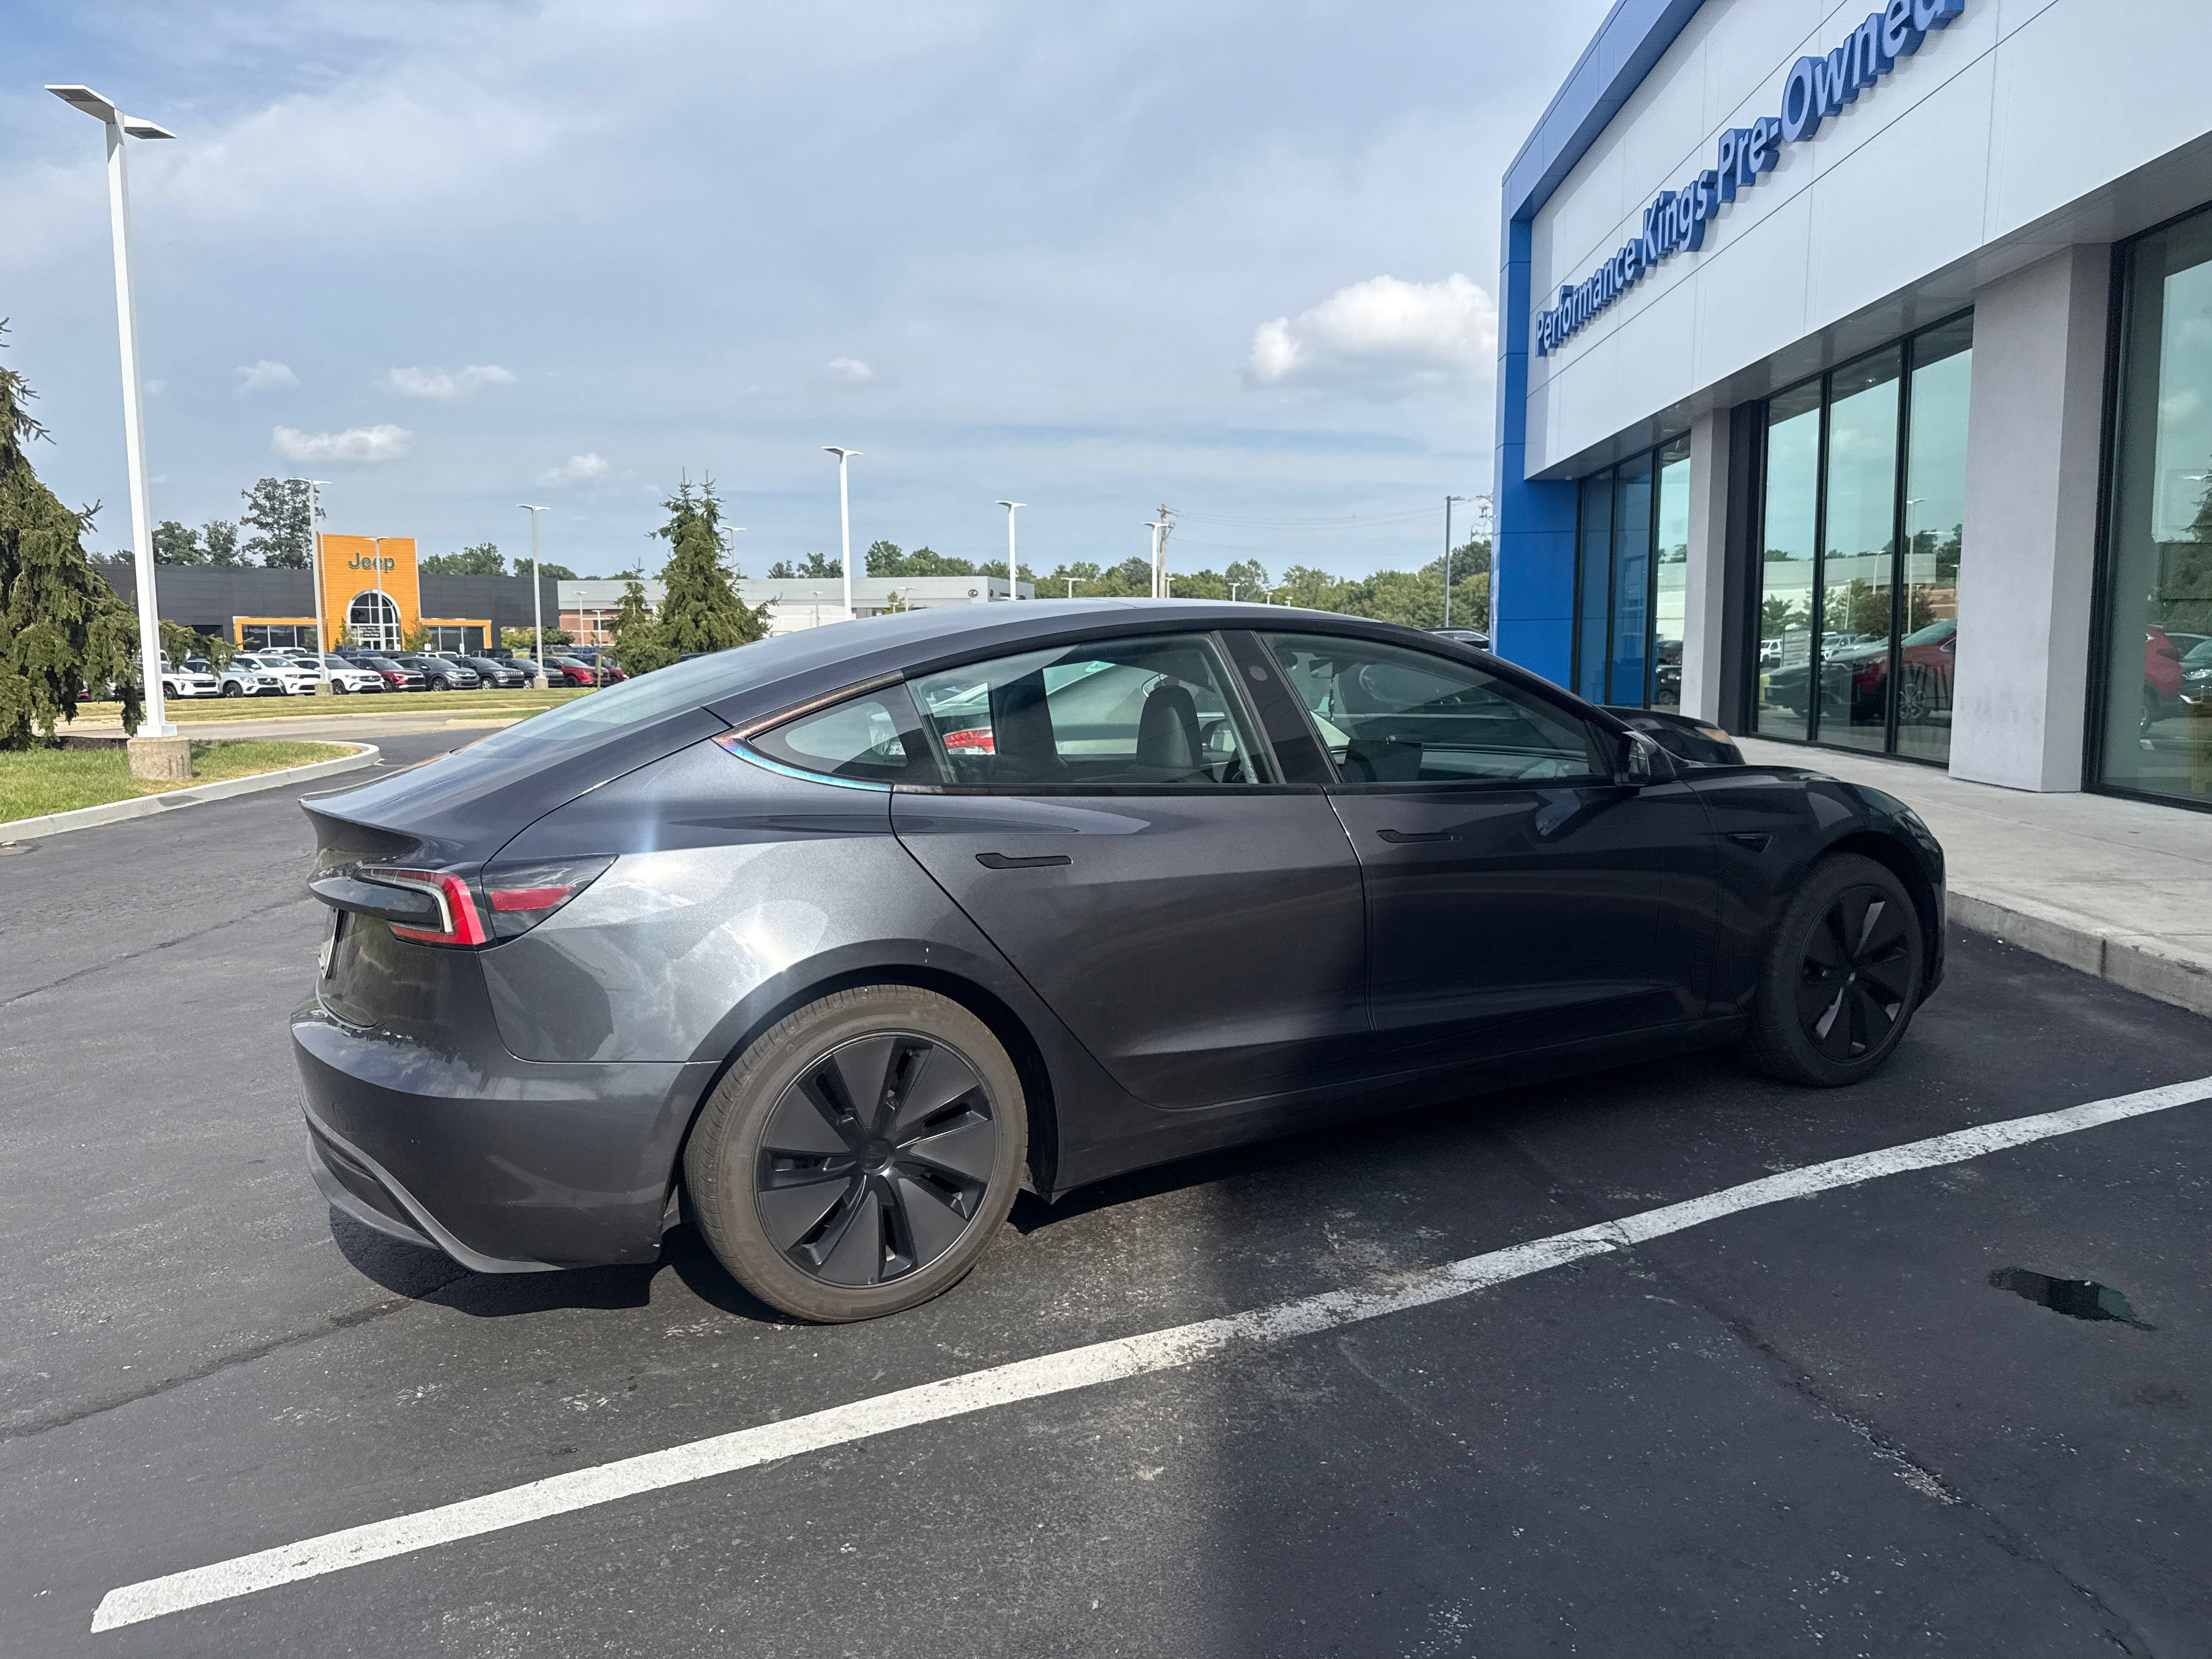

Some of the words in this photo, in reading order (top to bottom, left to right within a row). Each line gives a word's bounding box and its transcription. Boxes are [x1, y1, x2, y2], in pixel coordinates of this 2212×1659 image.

[1536, 238, 1644, 357] Performance
[1643, 170, 1717, 267] Kings
[348, 552, 395, 573] Jeep
